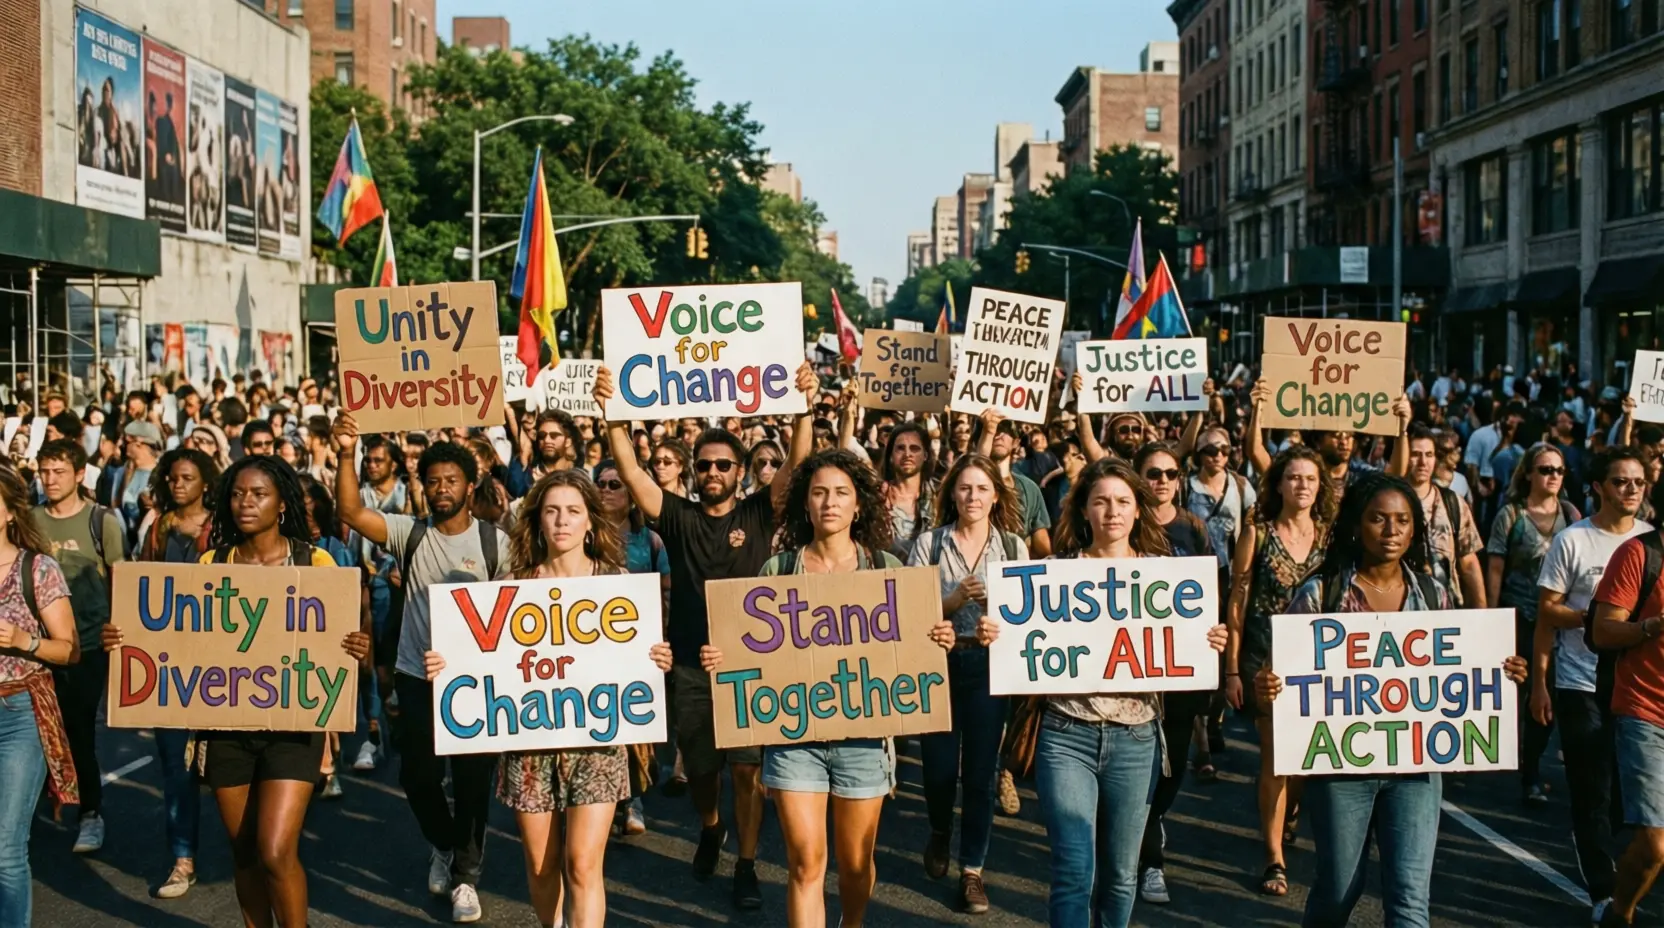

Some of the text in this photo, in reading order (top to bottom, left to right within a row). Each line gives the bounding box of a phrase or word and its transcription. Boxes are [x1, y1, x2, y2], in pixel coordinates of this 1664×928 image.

[355, 291, 474, 352] Unity
[627, 290, 765, 339] Voice
[981, 298, 1052, 328] PEACE
[401, 346, 430, 371] in
[675, 336, 728, 364] for
[876, 336, 939, 363] Stand
[1085, 344, 1197, 373] Justice
[1287, 322, 1382, 356] Voice
[619, 353, 789, 414] Change
[860, 372, 949, 402] Together
[889, 363, 921, 377] for
[965, 350, 1050, 384] THROUGH
[1093, 373, 1200, 403] for ALL
[1309, 355, 1361, 386] for
[343, 364, 498, 420] Diversity
[958, 379, 1043, 412] ACTION
[1276, 381, 1389, 429] Change
[138, 576, 326, 653] Unity in
[741, 578, 901, 654] Stand
[998, 564, 1204, 625] Justice
[450, 585, 639, 653] Voice
[516, 649, 575, 683] for
[1020, 626, 1194, 681] for ALL
[1309, 618, 1462, 670] PEACE
[119, 645, 348, 728] Diversity
[440, 674, 656, 742] Change
[716, 657, 944, 740] Together
[1301, 715, 1500, 770] ACTION
